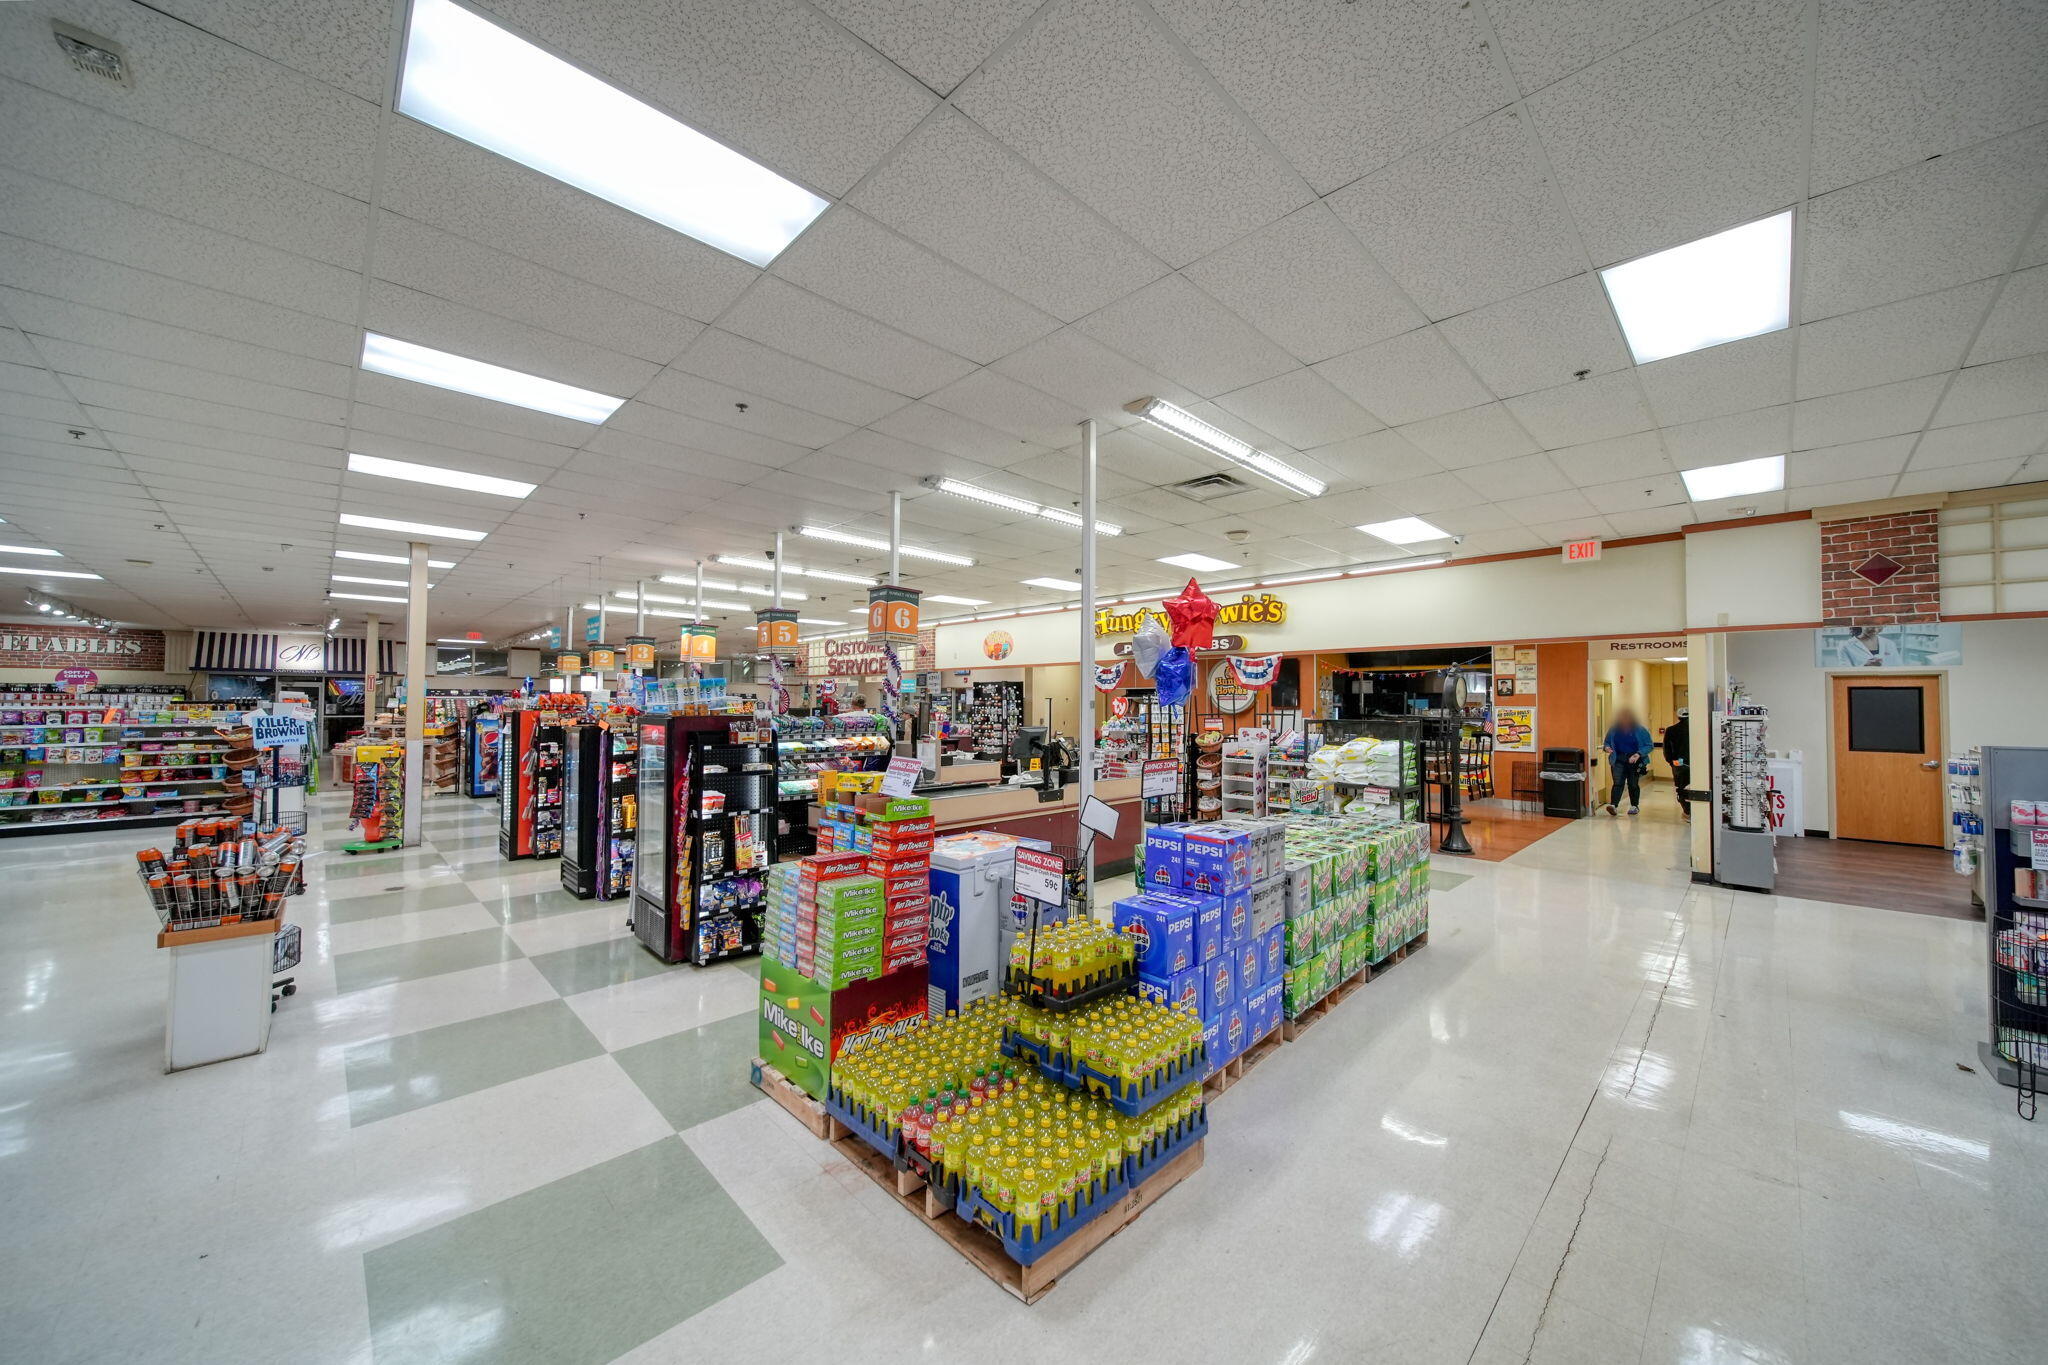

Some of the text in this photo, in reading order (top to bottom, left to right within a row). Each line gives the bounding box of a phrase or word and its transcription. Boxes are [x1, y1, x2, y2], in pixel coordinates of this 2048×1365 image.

[1569, 541, 1596, 560] EXIT
[873, 607, 882, 628] 6
[894, 607, 910, 629] 6
[1094, 593, 1284, 636] Hungry wie's
[778, 625, 791, 643] 5
[696, 639, 709, 654] 4
[825, 638, 885, 657] CUSTOME
[1211, 638, 1230, 651] BS
[599, 652, 609, 663] 2
[637, 646, 649, 659] 3
[827, 657, 889, 676] SERVICE
[257, 716, 298, 728] KILLER
[255, 725, 306, 740] BROWNIE
[1144, 762, 1164, 771] SAVINGS
[897, 822, 930, 834] HOT TAMALES
[896, 840, 930, 853] HOT TAMALES
[1147, 836, 1182, 852] PEPSI
[1186, 842, 1223, 858] PEPSI
[1017, 850, 1042, 864] SAVINGS
[823, 862, 861, 875] HOT TAMALES
[891, 860, 925, 873] HOT TAMALES
[892, 879, 924, 892] HOT TAMALES
[1044, 878, 1058, 891] 59¢
[1195, 883, 1211, 892] PEPSI
[843, 889, 862, 898] Mike
[893, 897, 925, 911] HOT TAMALES
[1011, 901, 1028, 911] PEPSI
[844, 906, 877, 918] Mike Ike
[1200, 906, 1221, 925] PEPSI
[892, 916, 924, 931] HOT TAMALES
[1168, 916, 1193, 935] PEPSI
[843, 926, 876, 939] Mike Ike
[891, 934, 924, 950] HOT TAMALES
[842, 945, 875, 959] Mike Ike
[888, 954, 921, 970] HOT TAMALES
[841, 966, 874, 980] Mike Ike
[1138, 980, 1168, 999] EPSI
[1266, 982, 1283, 998] PEPSI
[1180, 997, 1197, 1011] PEPSI
[1248, 993, 1266, 1011] PEPSI
[764, 997, 798, 1039] Mike
[801, 1024, 824, 1059] Ike
[840, 1011, 925, 1056] HOT TAMALES
[1203, 1023, 1219, 1041] EPSI
